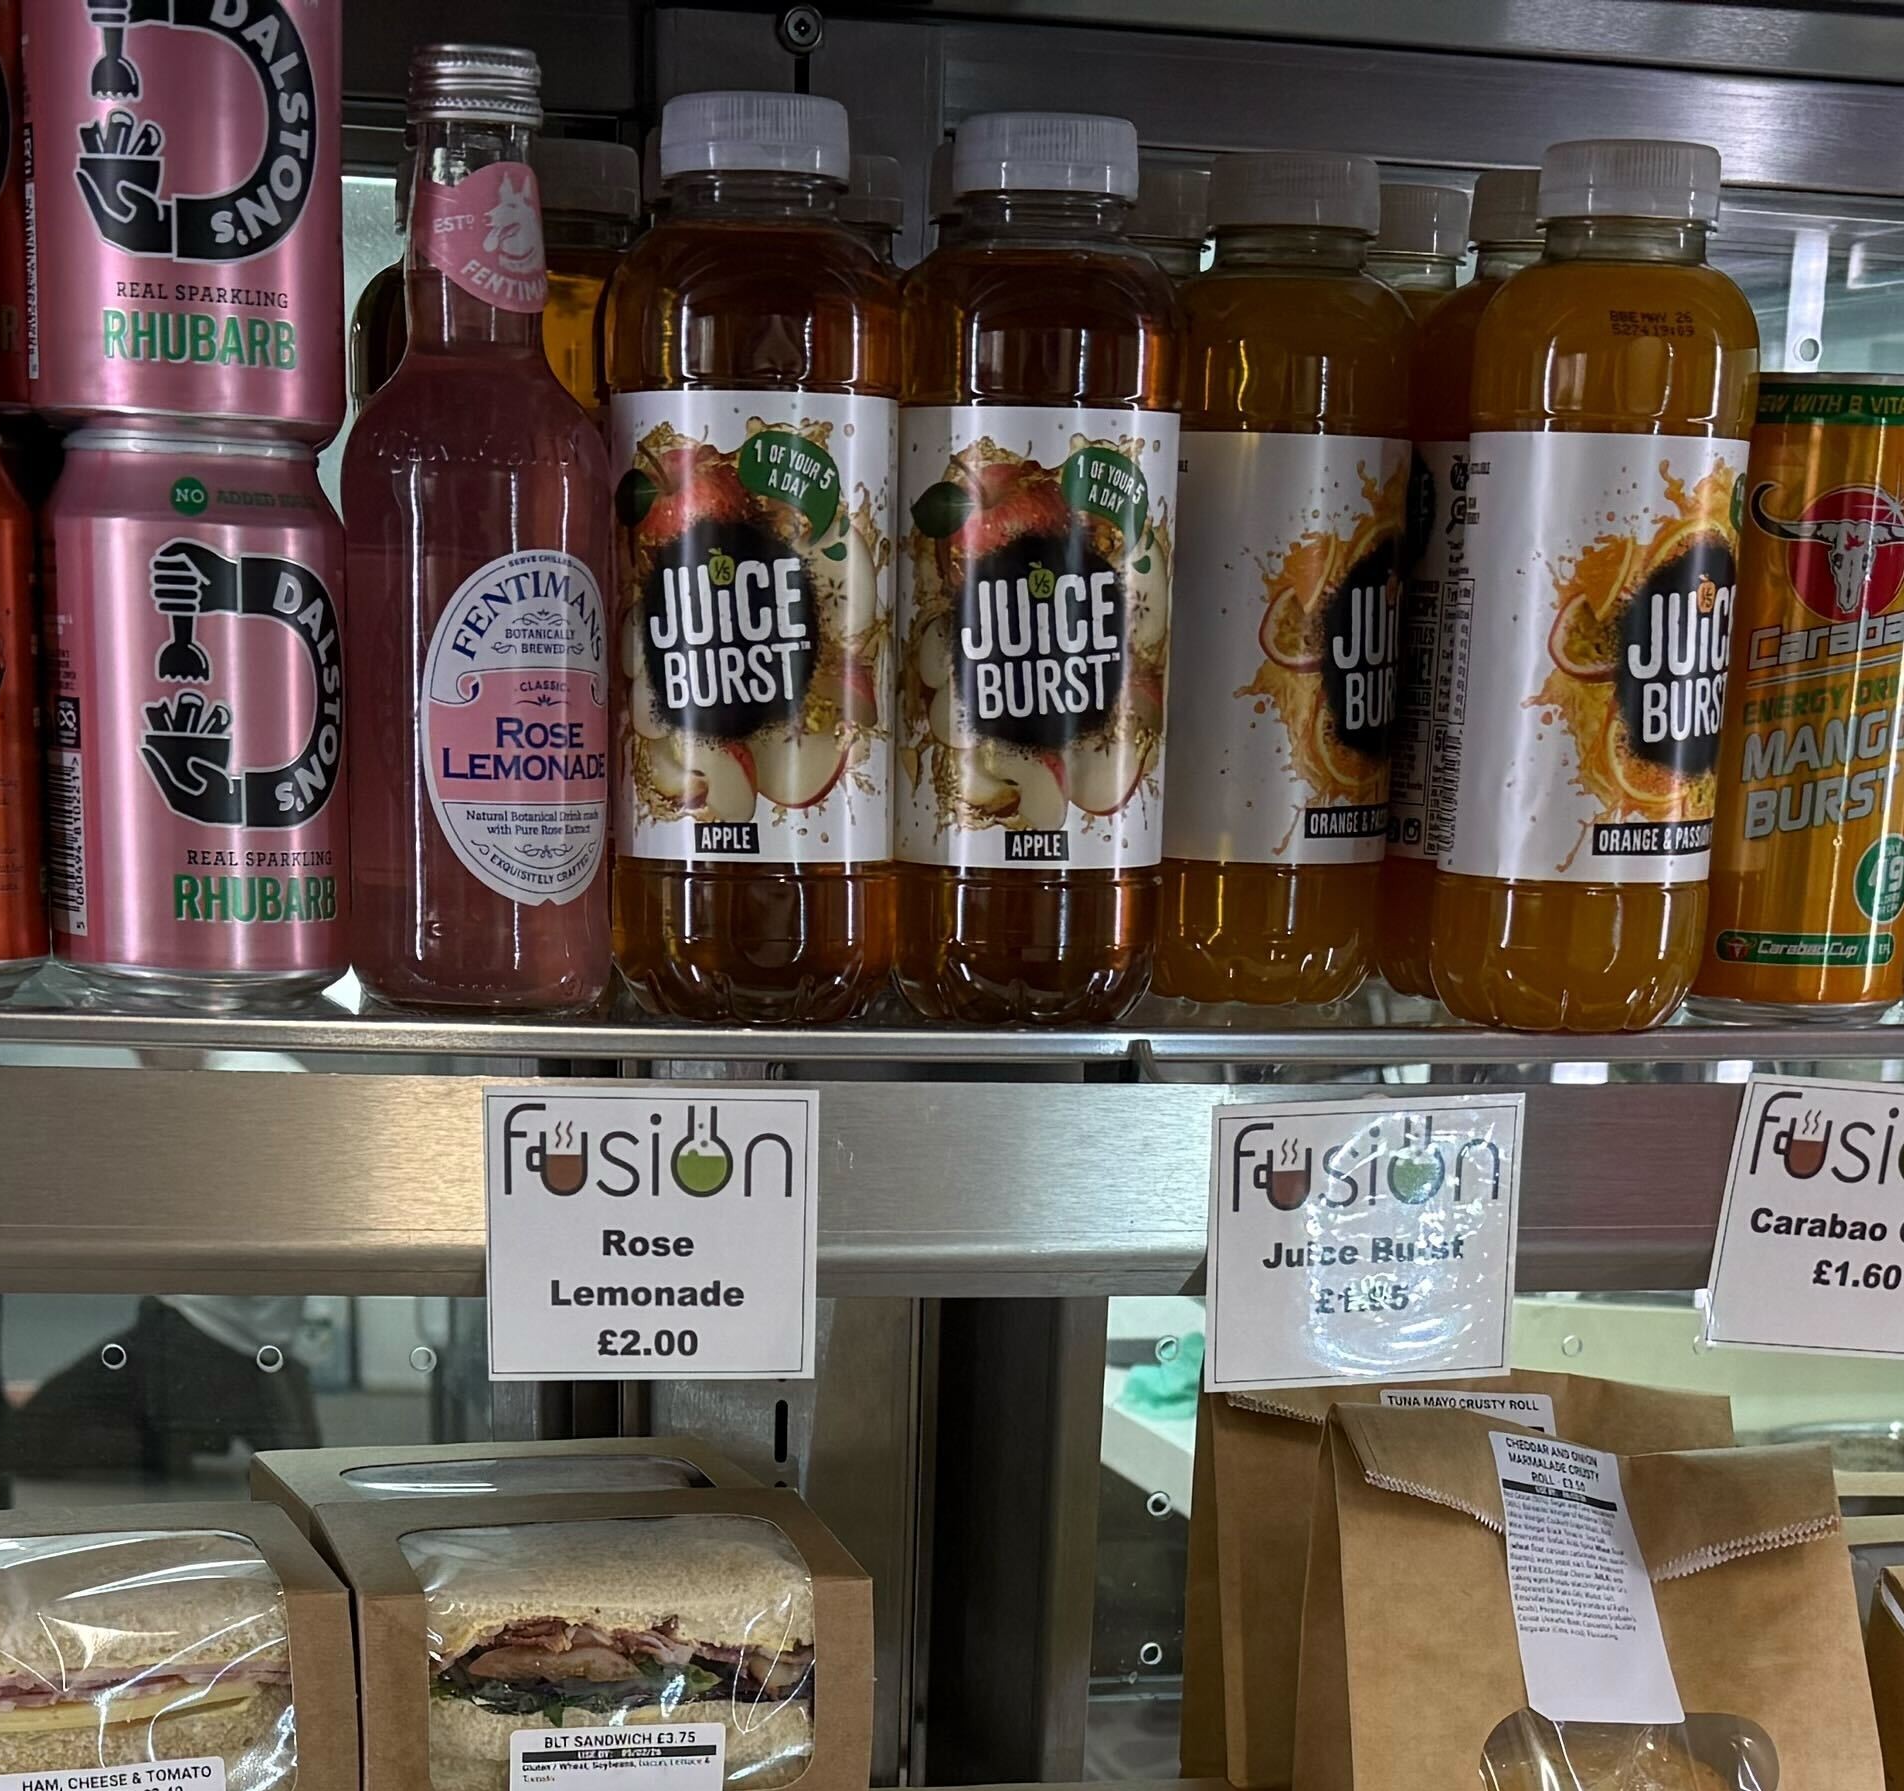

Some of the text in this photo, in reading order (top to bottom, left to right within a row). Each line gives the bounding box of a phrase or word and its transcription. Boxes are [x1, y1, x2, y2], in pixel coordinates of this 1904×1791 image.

[116, 281, 288, 308] REAL SPARKLING
[103, 307, 296, 371] RHUBARB
[770, 444, 786, 464] OF
[789, 450, 820, 483] YOUR
[820, 468, 835, 490] 5
[768, 470, 809, 498] A DAY
[1090, 460, 1105, 480] OF
[1108, 466, 1134, 496] YOUR
[1132, 485, 1144, 505] 5
[1101, 490, 1123, 513] DAY
[451, 570, 602, 662] FENTIMANS
[505, 629, 575, 640] BOTANICALLY
[664, 642, 799, 709] BURST
[976, 654, 1111, 719] BURST
[1744, 763, 1902, 840] BURST
[466, 810, 507, 821] Natural
[511, 811, 557, 821] Botanical
[487, 825, 511, 835] with
[516, 825, 538, 835] Pure
[541, 826, 562, 835] Rose
[702, 828, 753, 849] APPLE
[188, 850, 332, 868] REAL SPARKLING
[1011, 836, 1063, 857] APPLE
[174, 874, 337, 923] RHUBARB
[1751, 1208, 1887, 1241] Carabao
[602, 1229, 694, 1256] Rose
[1263, 1242, 1358, 1268] Juice
[1813, 1260, 1902, 1290] £1.60
[551, 1280, 744, 1306] Lemonade
[598, 1330, 697, 1356] £2.00
[1387, 1395, 1538, 1411] TUNA MAYO CRUSTY ROLL
[544, 1731, 696, 1749] BLT SANDWICH £3.75
[68, 1774, 128, 1790] CHEESE
[132, 1772, 142, 1785] &
[146, 1765, 212, 1782] TOMATO
